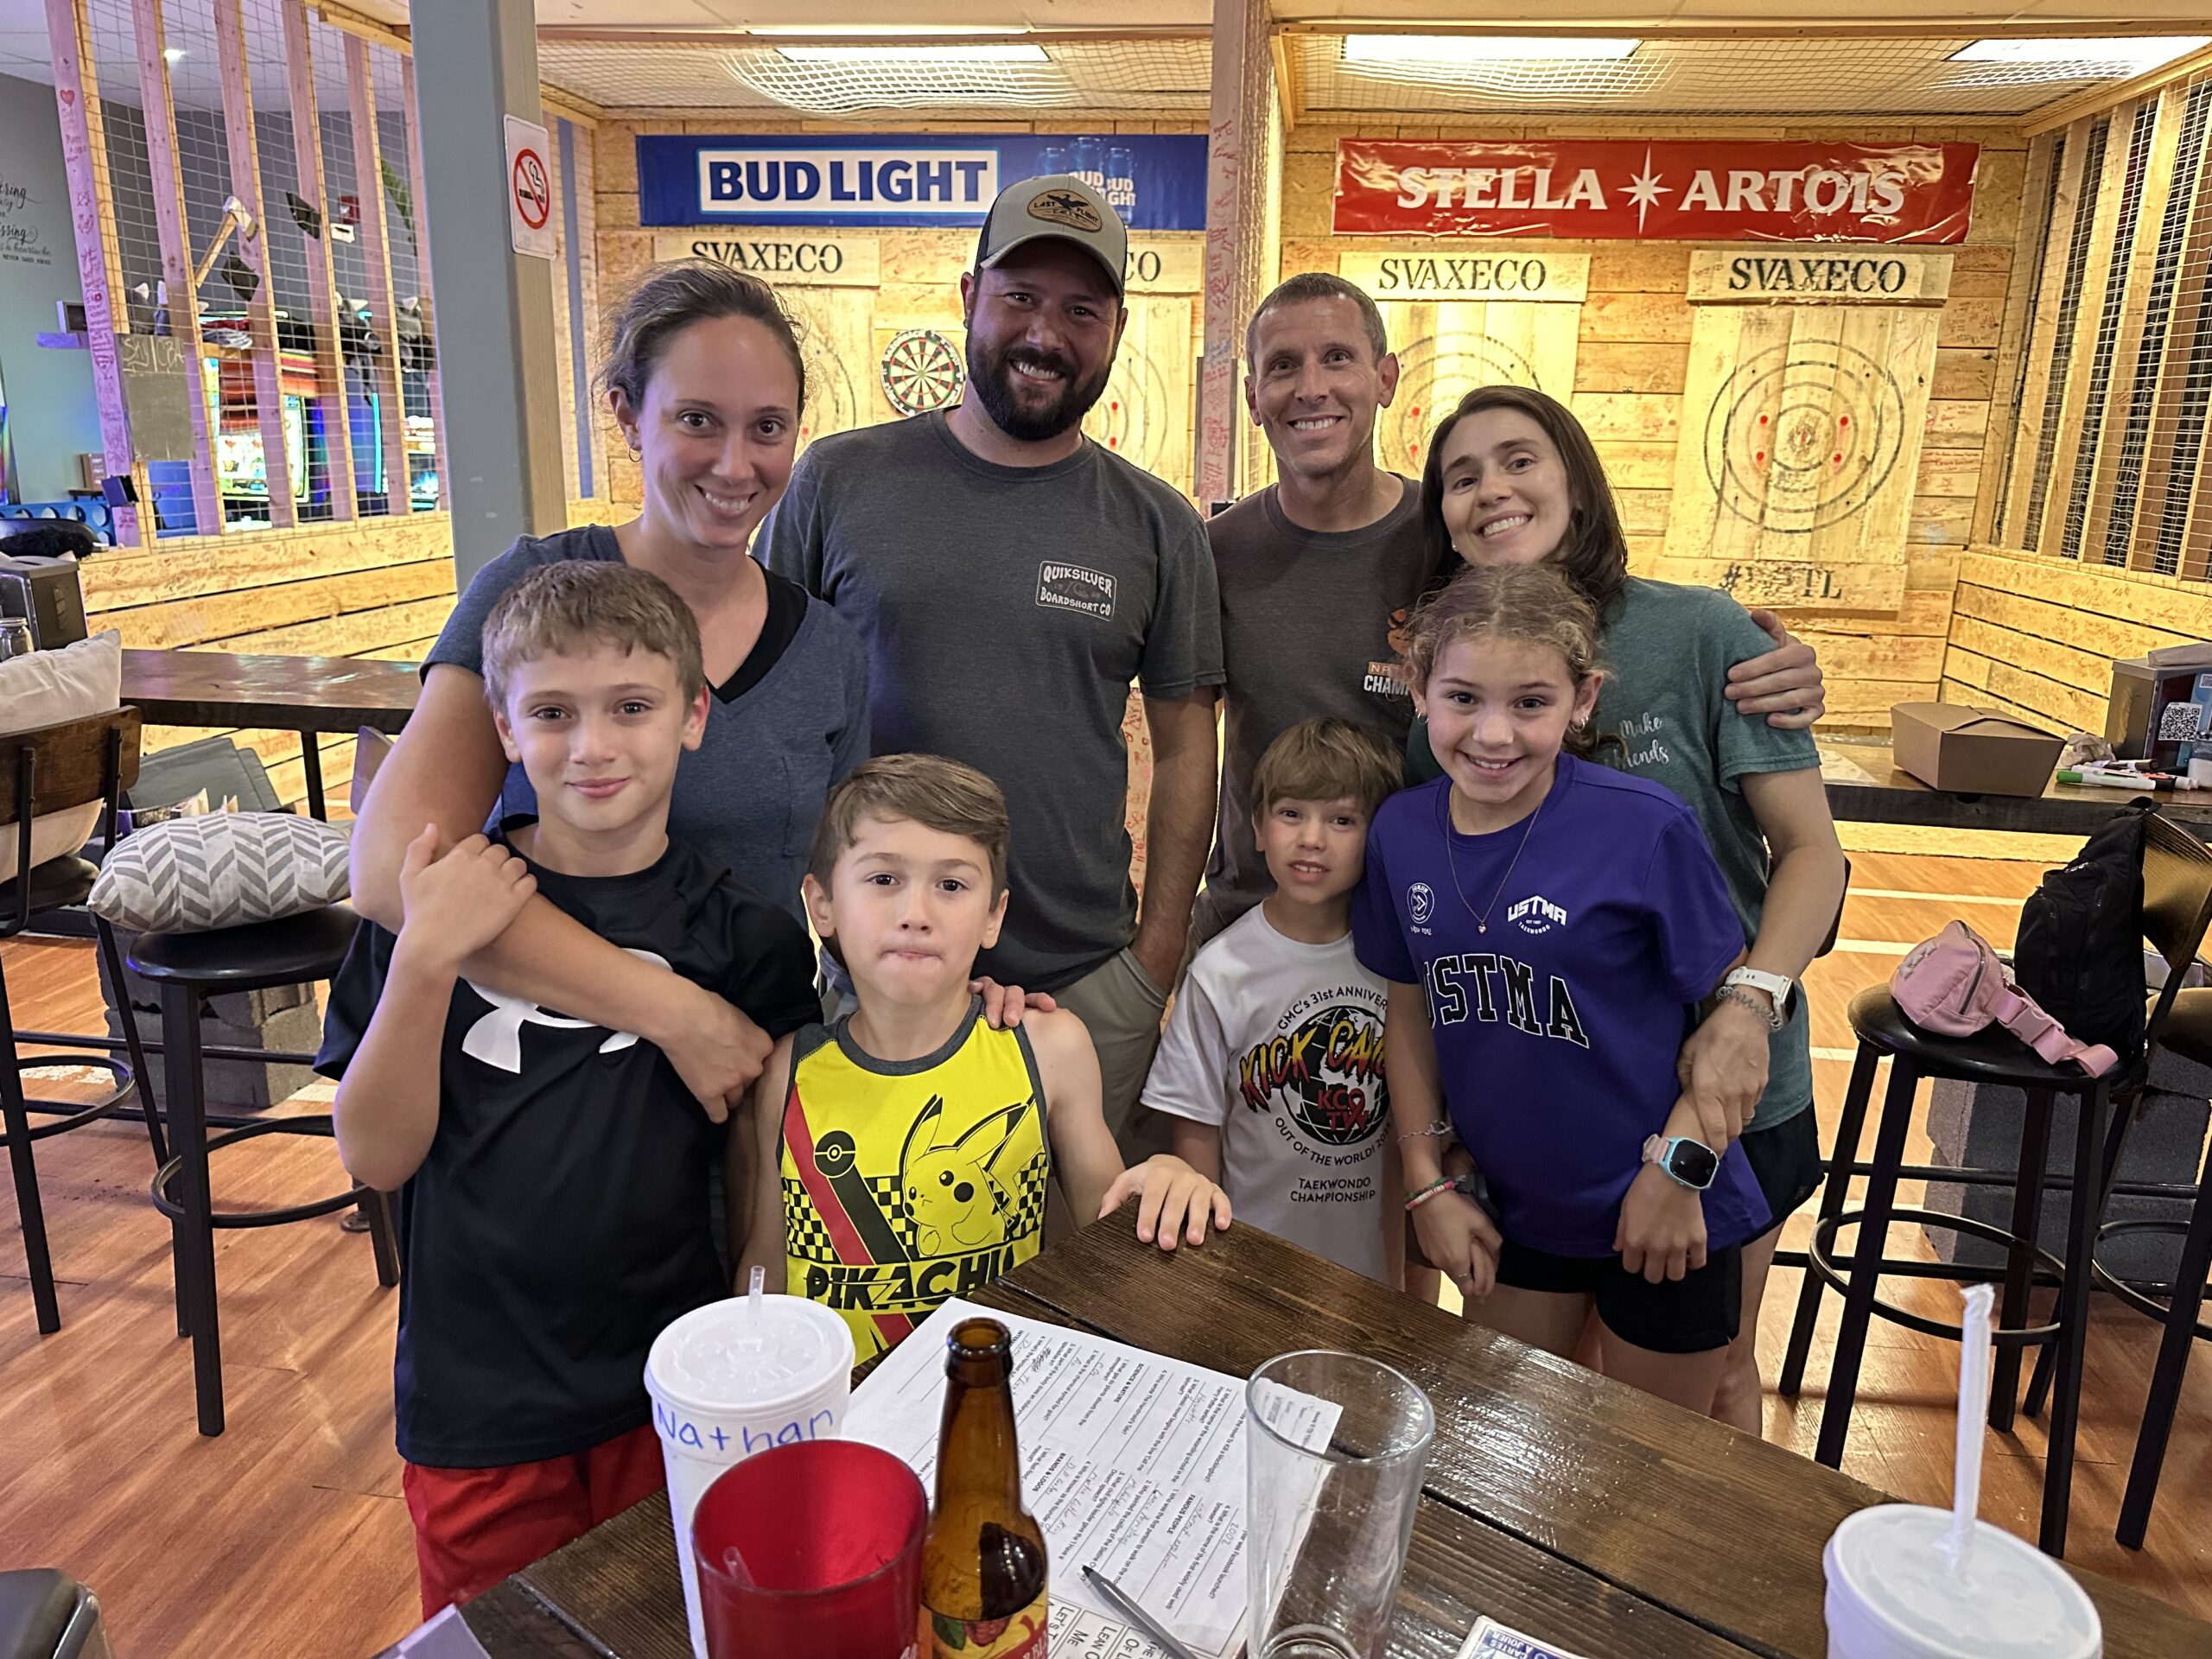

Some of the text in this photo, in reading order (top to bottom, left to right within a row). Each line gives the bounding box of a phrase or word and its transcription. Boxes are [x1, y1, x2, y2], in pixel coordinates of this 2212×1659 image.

[709, 161, 988, 202] BUD LIGHT
[1396, 165, 1905, 215] STELLA ARTOIS
[1379, 258, 1547, 291] SVAXECO
[1728, 257, 1907, 294] SVAXECO
[1043, 565, 1113, 598] QUIKSILVER
[1039, 586, 1111, 616] BOARDSHORT CO
[1618, 712, 1662, 739] Make
[1507, 895, 1567, 926] USTMA
[1310, 988, 1333, 1005] 31st
[1336, 986, 1388, 1011] ANNIVER
[1239, 1026, 1318, 1113] KICK
[1275, 1117, 1375, 1166] OUT OF THE WORLD!
[1299, 1177, 1370, 1190] TAEKWONDO
[1290, 1190, 1376, 1203] CHAMPIONSHIP
[1029, 1339, 1043, 1351] What's
[1060, 1347, 1072, 1357] What
[1084, 1353, 1096, 1363] What
[1102, 1357, 1122, 1381] atmosphere?
[1116, 1362, 1127, 1372] What
[1128, 1363, 1144, 1381] SCIENCE
[1039, 1376, 1050, 1385] body
[1064, 1374, 1080, 1390] chemical
[1154, 1373, 1165, 1382] Who
[1032, 1385, 1043, 1394] does
[1098, 1384, 1110, 1396] plants
[1113, 1385, 1128, 1402] NATURE
[1147, 1382, 1159, 1394] wrote
[1185, 1382, 1196, 1393] What
[1054, 1390, 1068, 1404] symbol
[1177, 1393, 1190, 1406] classic
[1218, 1392, 1229, 1402] What
[1198, 1386, 1224, 1423] Harry Potter series?
[1042, 1409, 1054, 1421] gold?
[1082, 1409, 1093, 1419] from
[1127, 1401, 1146, 1424] Handmaid's
[1170, 1407, 1181, 1417] novel
[1161, 1417, 1174, 1431] begins
[1205, 1414, 1216, 1425] name
[658, 1403, 834, 1454] Nathan
[1120, 1424, 1131, 1434] Tale?
[1156, 1430, 1166, 1440] with
[1228, 1427, 1238, 1438] novel
[1186, 1436, 1202, 1456] wizarding
[1026, 1445, 1043, 1462] mascot?
[1020, 1451, 1047, 1479] What fast-food
[1047, 1452, 1066, 1471] BRANDS
[1178, 1456, 1190, 1470] school
[1204, 1454, 1224, 1482] Mockingbird?
[1077, 1465, 1088, 1474] Who
[1032, 1475, 1049, 1491] LOGOS
[1063, 1478, 1077, 1493] known
[1109, 1475, 1122, 1487] What
[1090, 1484, 1107, 1501] speech?
[1103, 1487, 1114, 1496] civil
[1137, 1484, 1148, 1494] Who
[1094, 1496, 1108, 1508] rights
[1126, 1494, 1141, 1511] painted
[1165, 1491, 1176, 1502] Who
[1041, 1505, 1058, 1522] founder
[1159, 1502, 1169, 1511] was
[1206, 1502, 1223, 1522] browser?
[1084, 1508, 1099, 1522] leader
[1166, 1494, 1195, 1534] FAMOUS PEOPLE
[1217, 1509, 1228, 1522] What
[1077, 1522, 1089, 1532] gave
[1111, 1518, 1126, 1533] ceiling
[1147, 1519, 1158, 1528] first
[1138, 1528, 1153, 1544] person
[1201, 1534, 1213, 1547] name
[1220, 1522, 1240, 1546] 2002
[1060, 1543, 1073, 1555] Have
[1233, 1541, 1243, 1550] was
[1092, 1546, 1107, 1561] Sistine
[1128, 1549, 1139, 1560] walk
[1188, 1560, 1198, 1570] first
[1221, 1550, 1237, 1573] Facebook
[1118, 1567, 1128, 1575] the
[1179, 1570, 1192, 1586] widely
[1171, 1586, 1183, 1598] used
[1207, 1573, 1225, 1599] launched?
[1165, 1598, 1175, 1609] web
[1065, 1630, 1088, 1647] ME
[1090, 1626, 1116, 1650] LEAN
[1492, 1630, 1523, 1649] JOUER
[1490, 1638, 1528, 1659] CARTES
